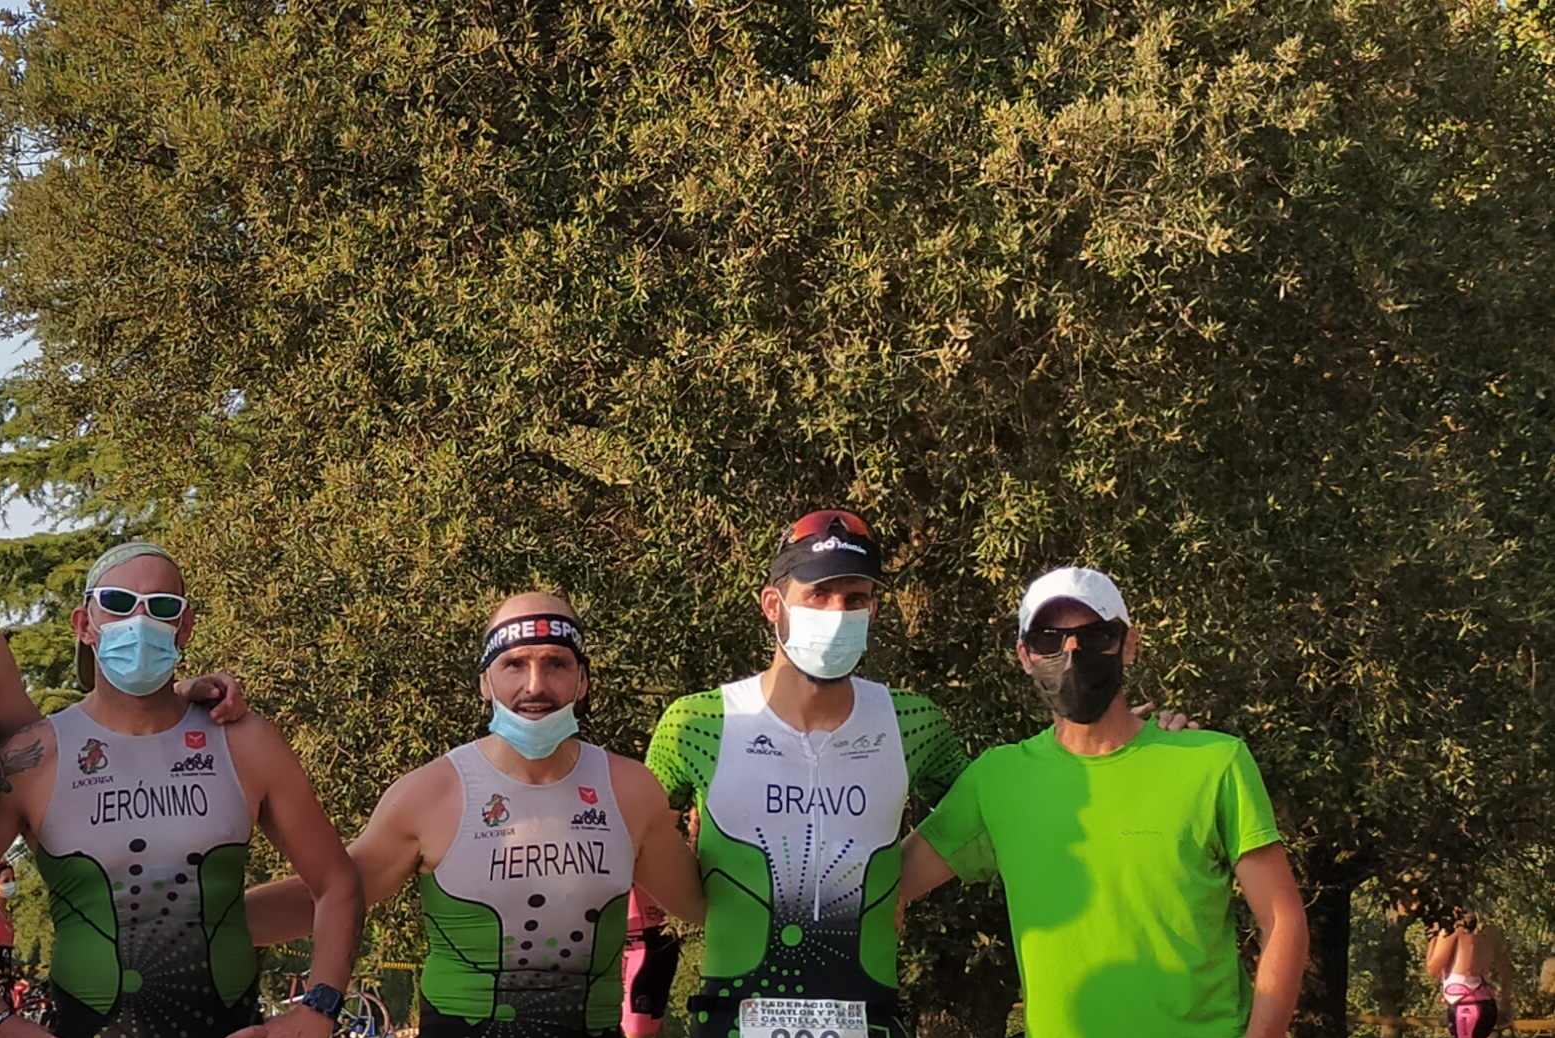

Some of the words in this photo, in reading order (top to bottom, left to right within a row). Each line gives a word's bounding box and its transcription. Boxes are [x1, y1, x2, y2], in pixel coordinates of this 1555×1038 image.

[90, 780, 208, 826] JERÓNIMO
[767, 784, 866, 816] BRAVO
[489, 841, 610, 881] HERRANZ
[760, 1008, 814, 1016] TRIATLON
[761, 1016, 819, 1024] CASTILLA
